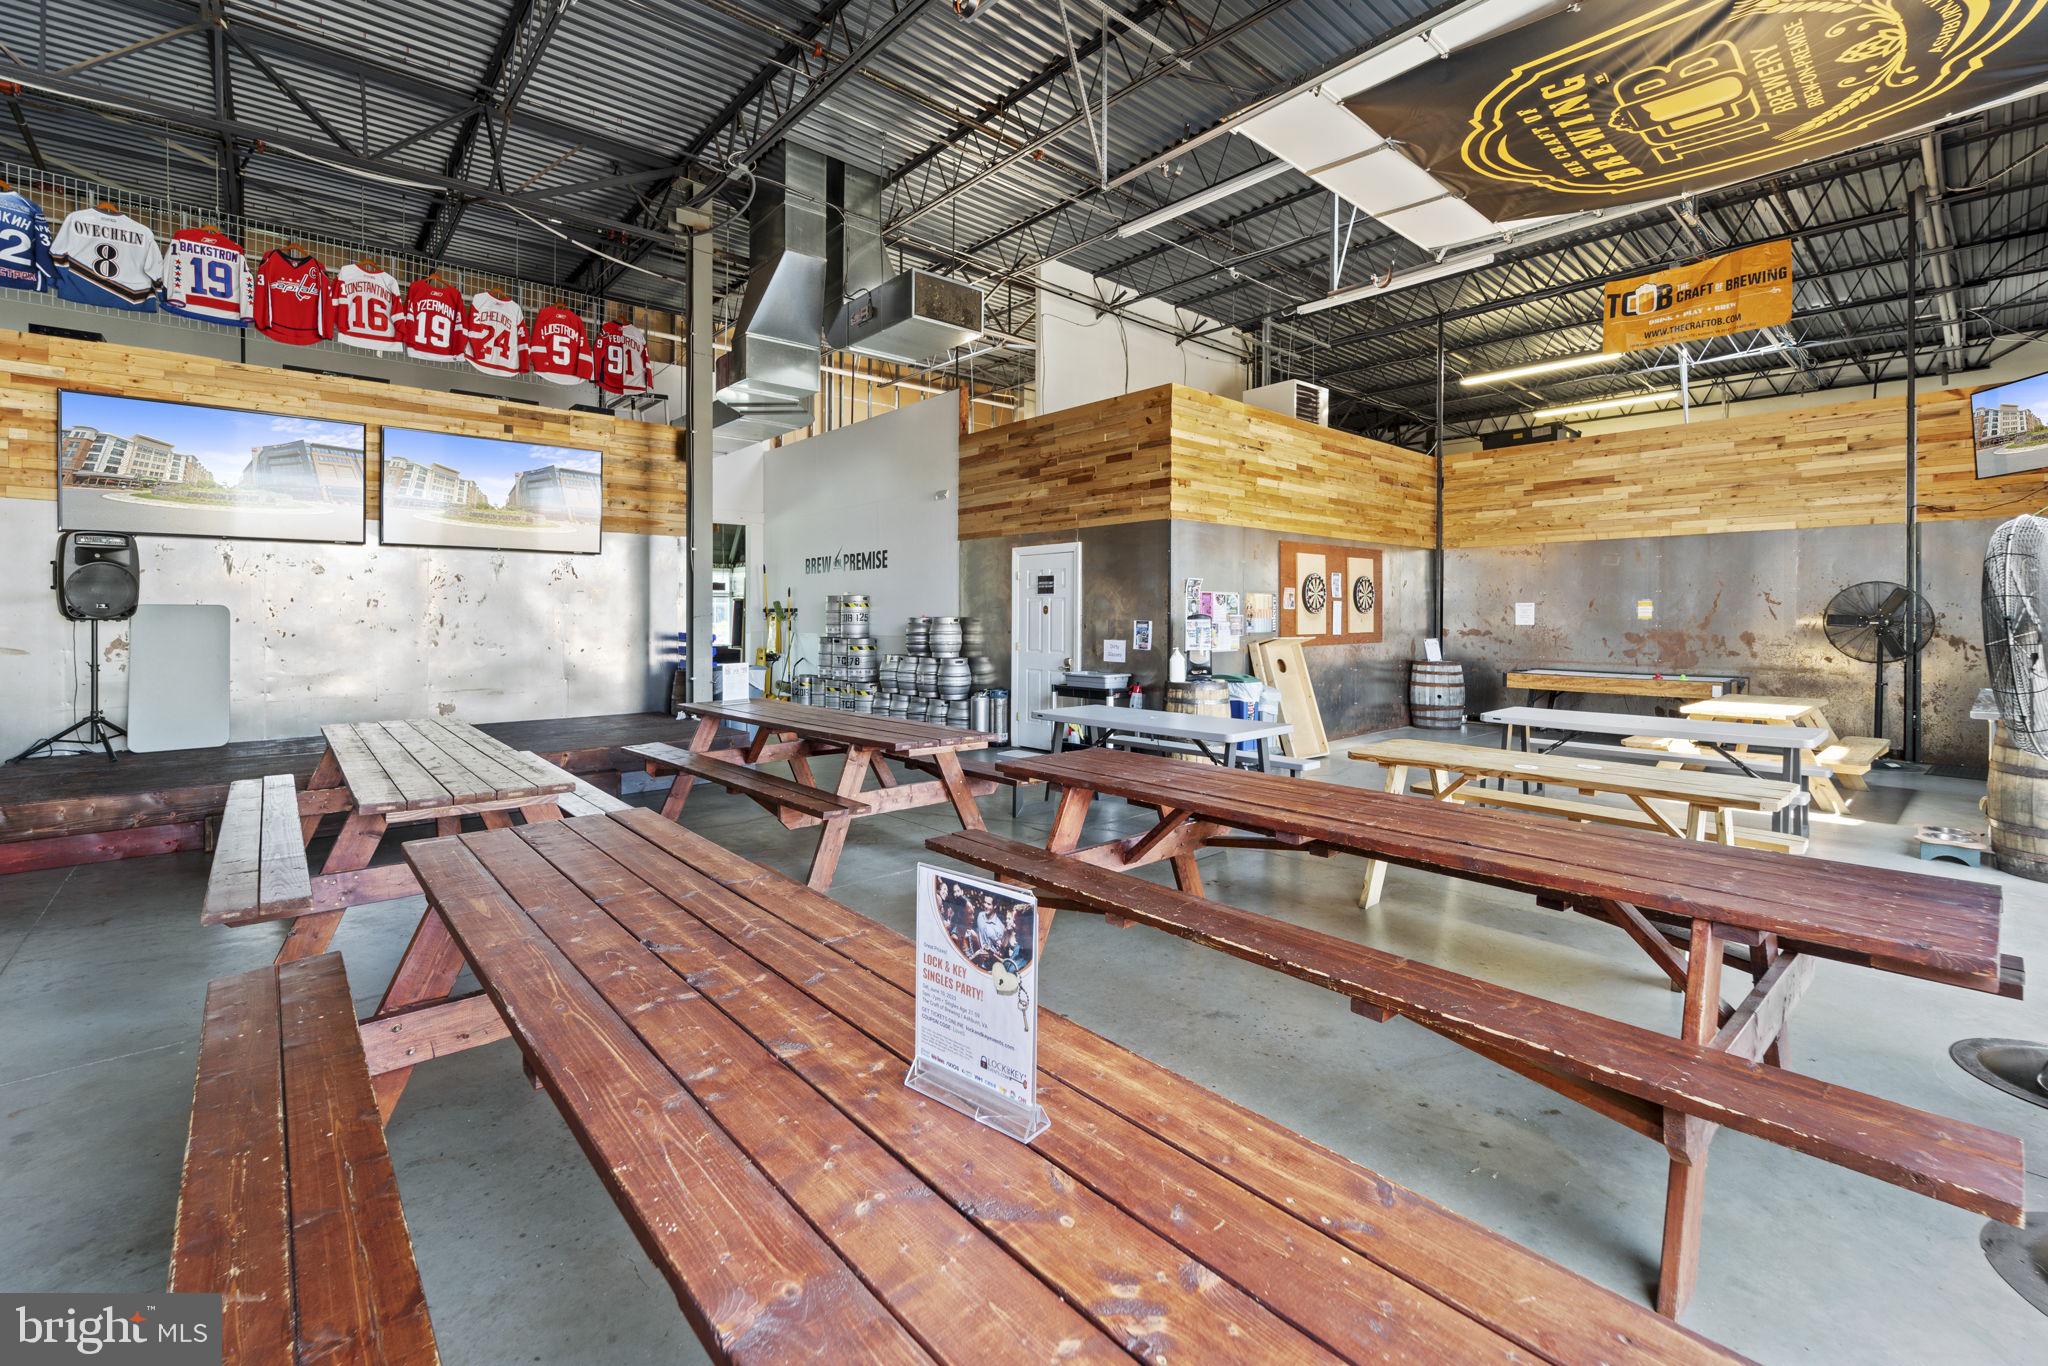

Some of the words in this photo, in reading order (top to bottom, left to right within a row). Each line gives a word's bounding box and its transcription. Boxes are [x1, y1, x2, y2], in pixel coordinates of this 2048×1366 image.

[1783, 18, 1825, 109] BREW-ON-PREMISE
[1750, 44, 1798, 114] BREWERY
[1516, 108, 1542, 124] OF
[1540, 73, 1644, 181] BREWING
[1532, 127, 1571, 160] CRAFT
[1562, 160, 1591, 178] THE
[0, 210, 32, 231] КИН
[74, 220, 144, 246] OVECHKIN
[92, 243, 120, 279] 8
[179, 241, 239, 264] BACKSTROM
[189, 257, 234, 299] 19
[344, 280, 391, 304] CONSTANTINO
[1676, 282, 1714, 303] CRAFT
[1714, 282, 1724, 293] OF
[1725, 266, 1788, 292] BREWING
[1676, 281, 1690, 292] THE
[351, 294, 389, 332] 16
[416, 298, 455, 321] YZERMAN
[480, 311, 512, 330] CHELIOS
[414, 311, 452, 348] 19
[544, 323, 579, 343] LIDSTROM
[1643, 312, 1743, 340] WWW.THECRAFTOB.COM
[477, 322, 511, 360] 24
[553, 334, 571, 367] 5
[608, 334, 641, 353] FEDOROV
[607, 345, 635, 377] 91
[805, 555, 832, 575] BREW
[843, 549, 889, 572] PREMISE
[923, 952, 943, 970] LOCK
[944, 960, 951, 973] &
[952, 963, 967, 979] KEY
[922, 967, 954, 990] SINGLES
[956, 981, 984, 1002] PARTY!
